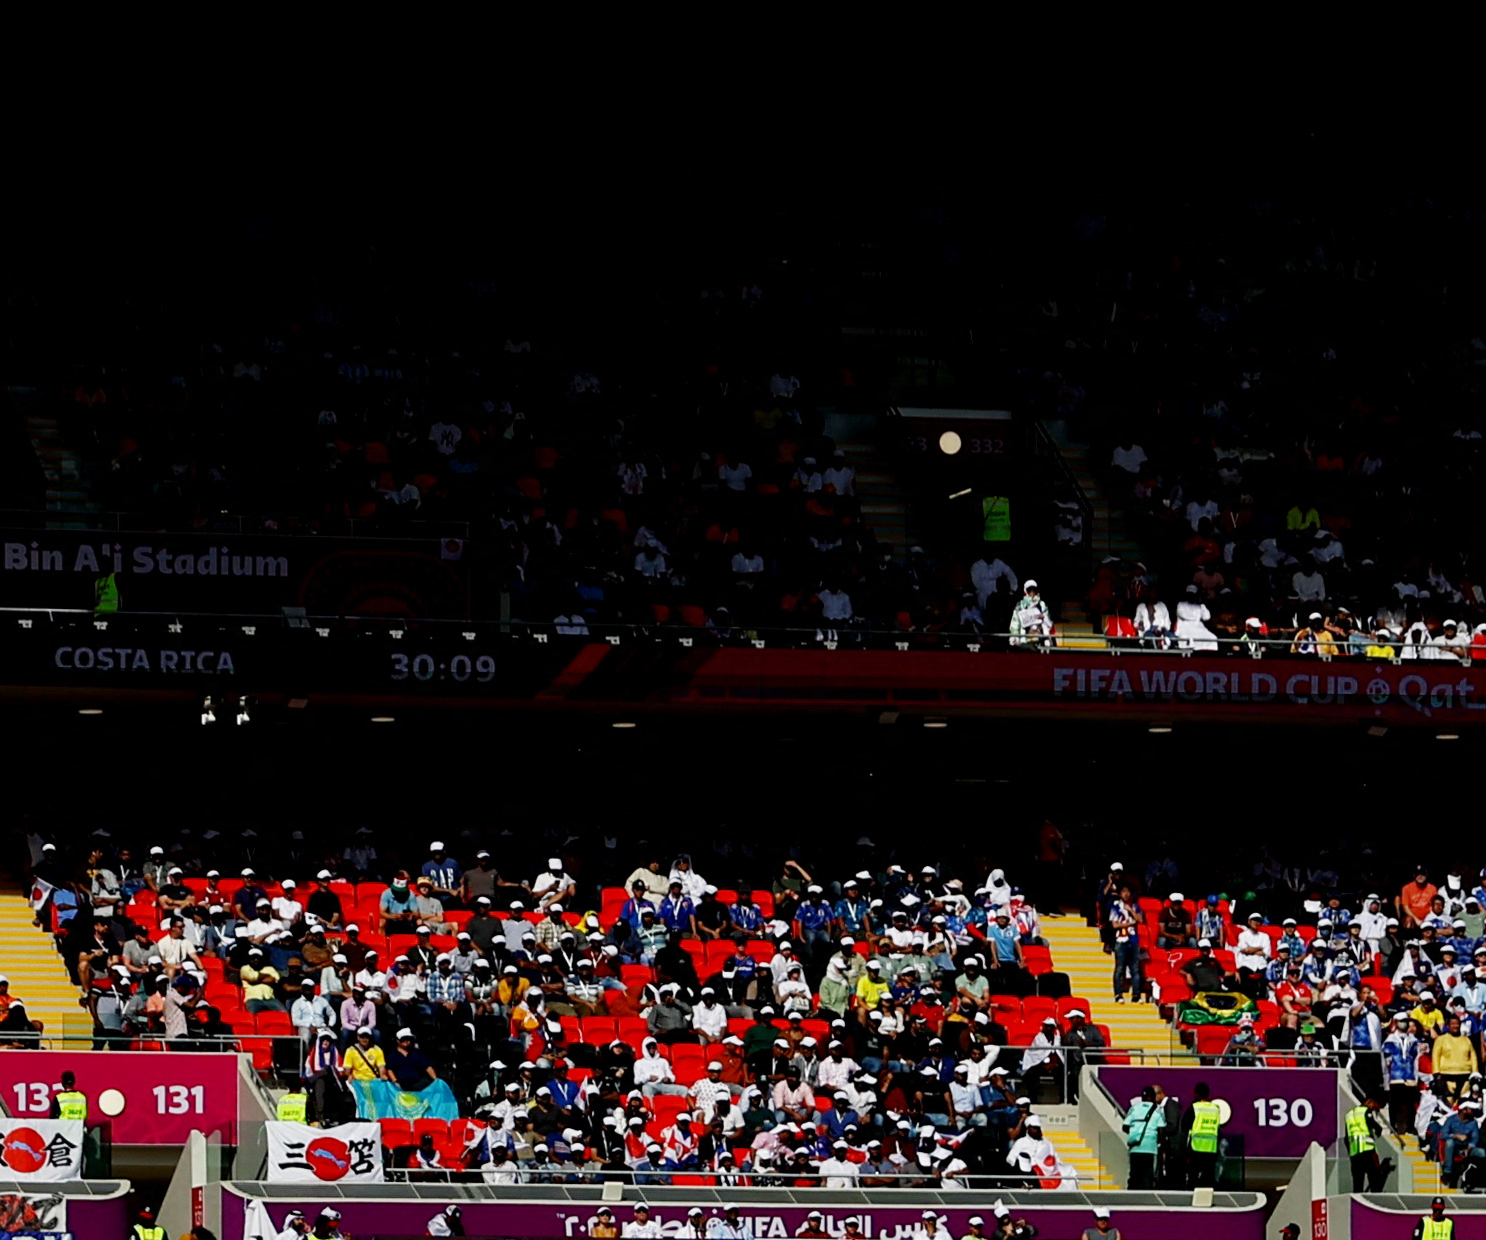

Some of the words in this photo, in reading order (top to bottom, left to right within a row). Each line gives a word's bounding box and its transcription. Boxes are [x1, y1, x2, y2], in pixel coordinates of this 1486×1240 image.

[3, 540, 63, 572] Bin
[132, 545, 289, 577] Stadium
[54, 646, 150, 673] COSTA
[159, 649, 235, 675] RICA
[389, 653, 496, 683] 30:09
[1053, 667, 1134, 700] FIFA
[1139, 669, 1278, 702] WORLD
[1285, 674, 1359, 704] CUP
[153, 1085, 204, 1114] 131
[1253, 1098, 1313, 1127] 130
